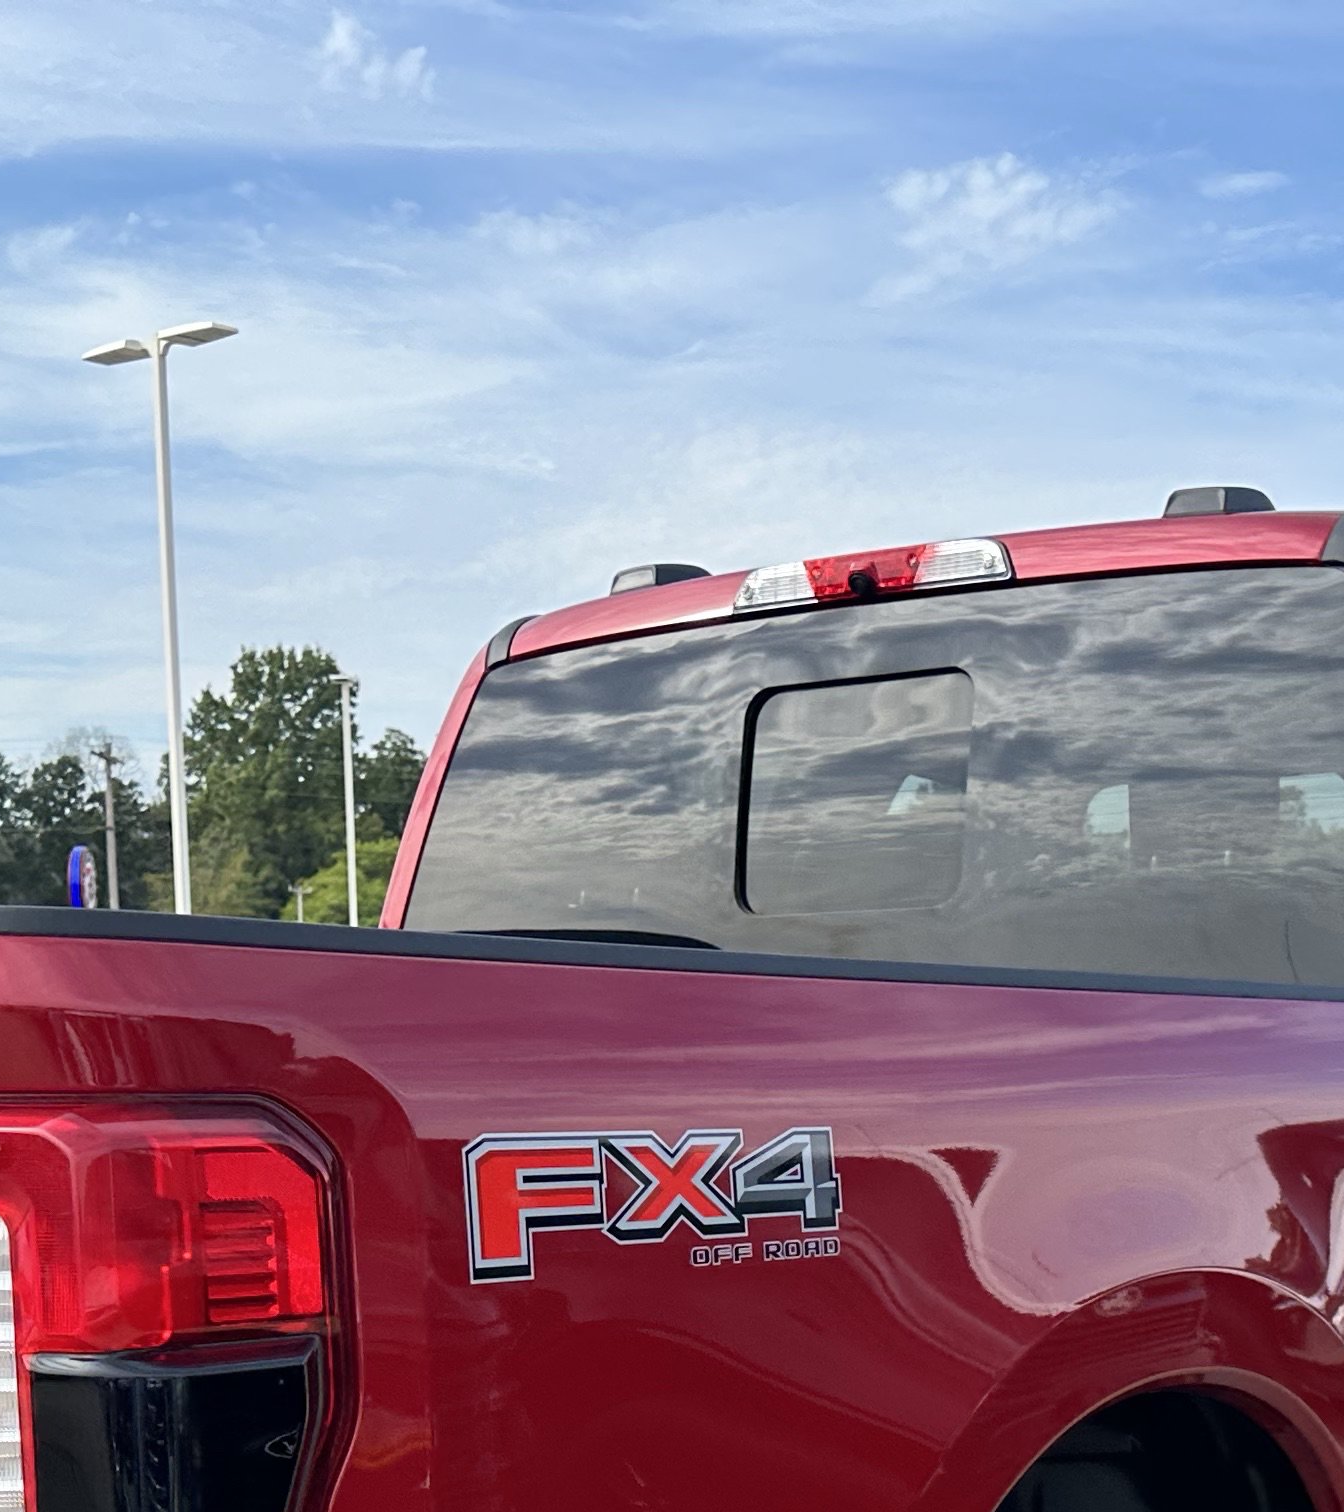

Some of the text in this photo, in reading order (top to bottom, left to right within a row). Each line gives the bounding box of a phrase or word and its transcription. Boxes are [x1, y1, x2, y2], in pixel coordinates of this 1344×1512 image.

[462, 1127, 842, 1284] FX4
[690, 1236, 841, 1267] OFF ROAD
